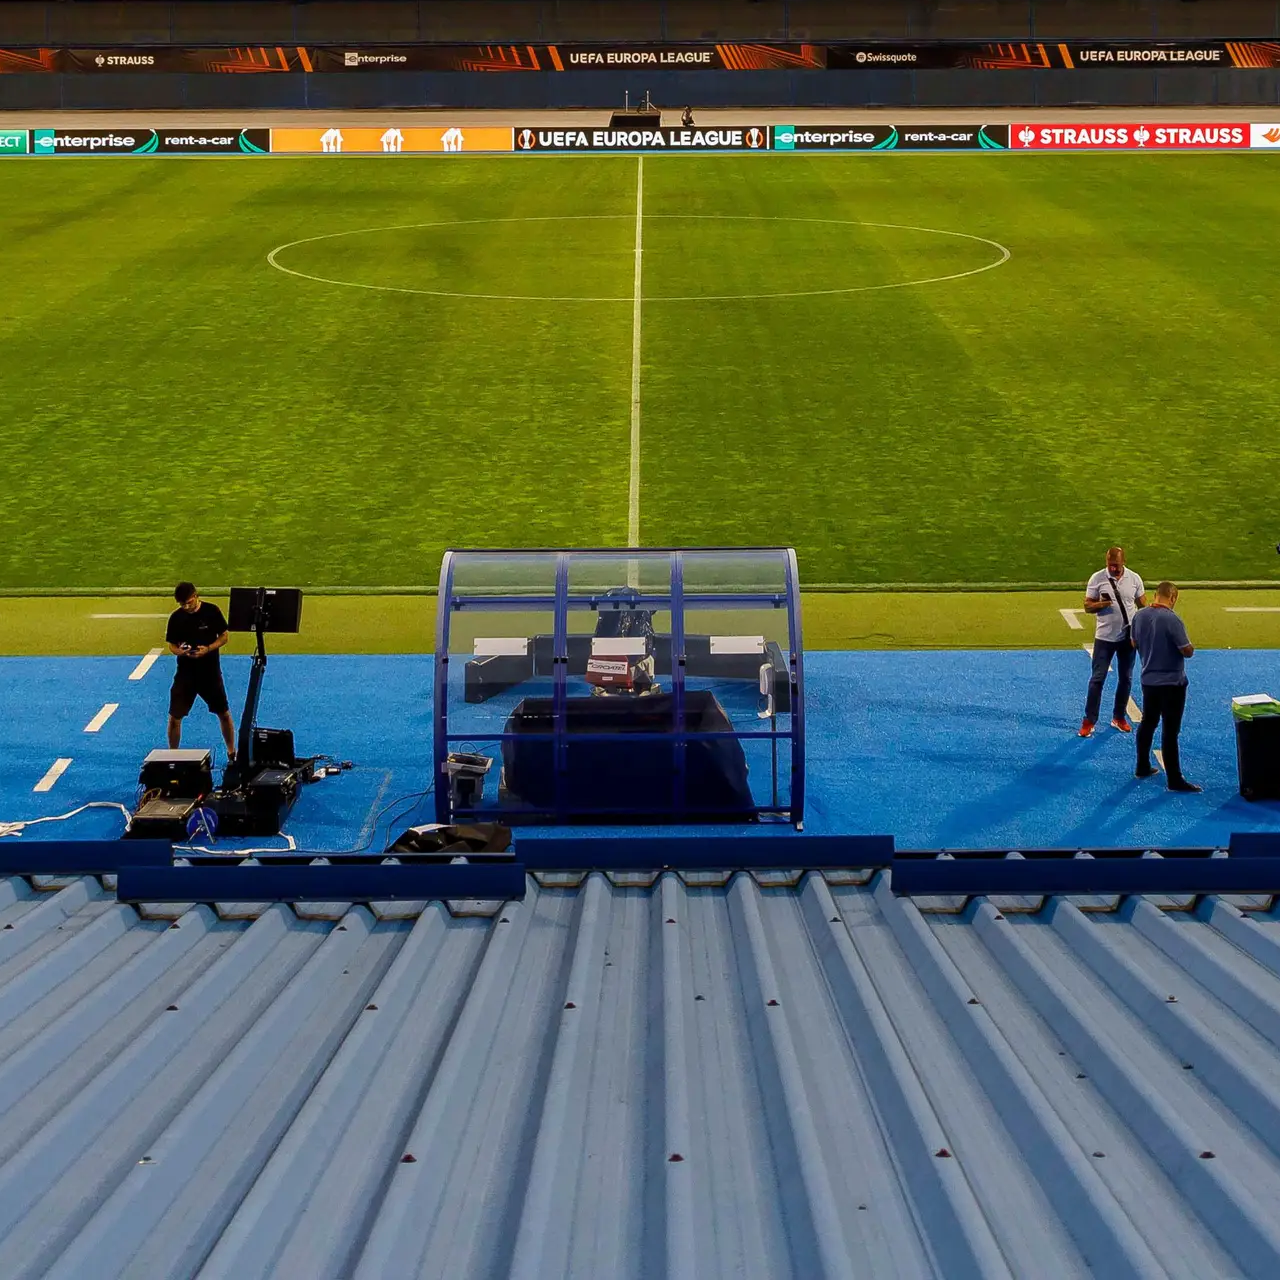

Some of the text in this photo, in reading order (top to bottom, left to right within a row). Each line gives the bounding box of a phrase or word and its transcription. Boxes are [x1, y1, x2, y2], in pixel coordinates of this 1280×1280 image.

[107, 56, 154, 64] STRAUSS
[350, 53, 407, 66] enterprise
[571, 53, 710, 63] UEFA EUROPA LEAGUE
[867, 53, 916, 63] Swissquote
[1080, 51, 1220, 61] UEFA EUROPA LEAGUE
[41, 133, 234, 149] enterprise rent-a-car
[539, 131, 742, 146] UEFA EUROPA LEAGUE
[782, 130, 973, 147] enterprise rent-a-car
[1040, 129, 1128, 144] STRAUSS
[1156, 128, 1243, 143] STRAUSS
